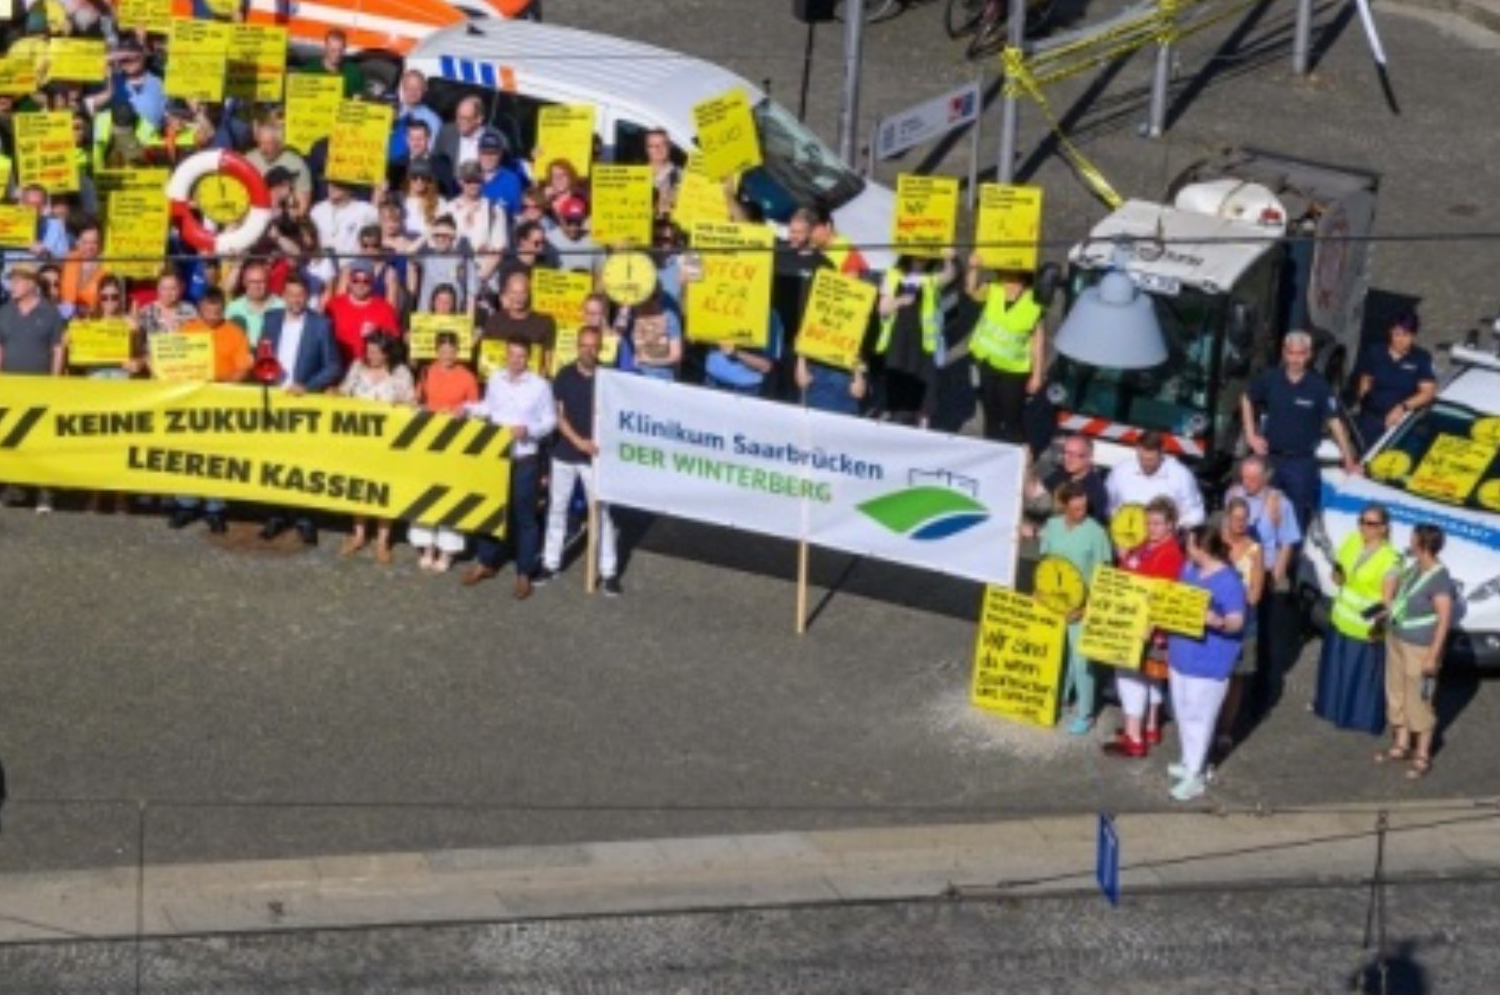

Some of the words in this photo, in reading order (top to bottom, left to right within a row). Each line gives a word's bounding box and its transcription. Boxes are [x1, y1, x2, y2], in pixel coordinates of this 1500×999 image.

[55, 410, 155, 437] KEINE
[164, 407, 322, 433] ZUKUNFT
[330, 410, 387, 437] MIT
[618, 409, 725, 451] Klinikum
[733, 433, 885, 481] Saarbrücken
[127, 445, 252, 484] LEEREN
[260, 461, 390, 507] KASSEN
[618, 441, 666, 469] DER
[673, 453, 833, 502] WINTERBERG
